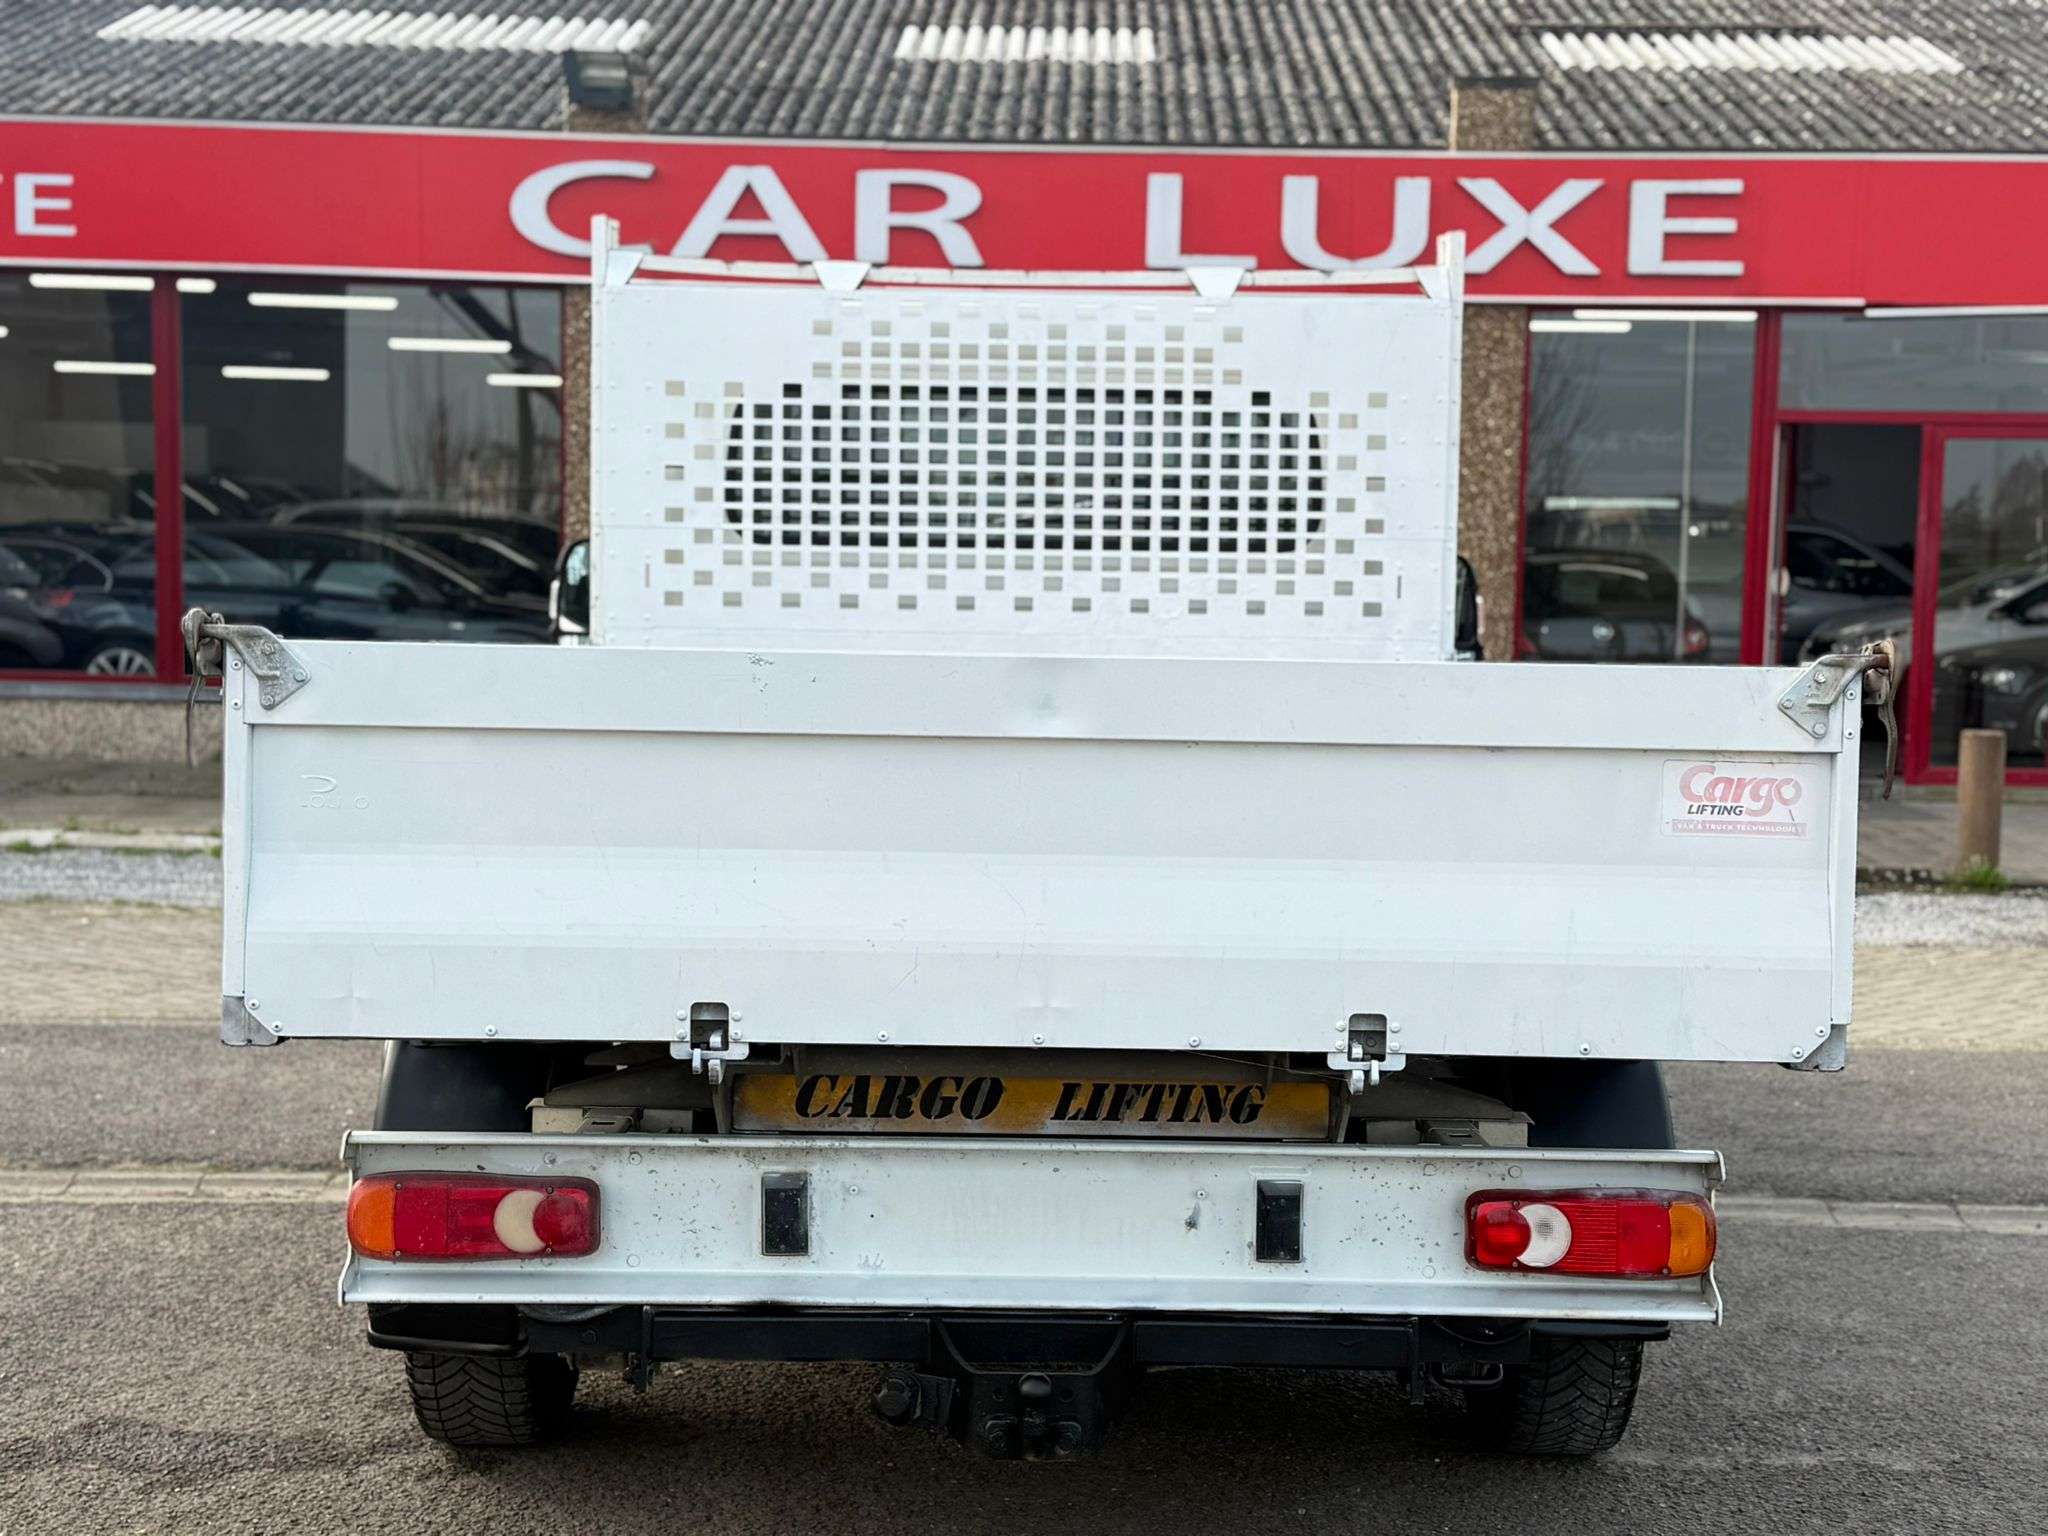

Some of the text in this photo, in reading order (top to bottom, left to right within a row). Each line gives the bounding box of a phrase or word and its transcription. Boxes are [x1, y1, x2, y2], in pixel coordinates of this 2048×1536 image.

[0, 172, 78, 238] E
[508, 160, 1746, 278] CAR LUXE
[1679, 764, 1802, 818] Cargo
[1687, 804, 1745, 816] LIFTING
[795, 1074, 1266, 1125] CARGO LIFTING
